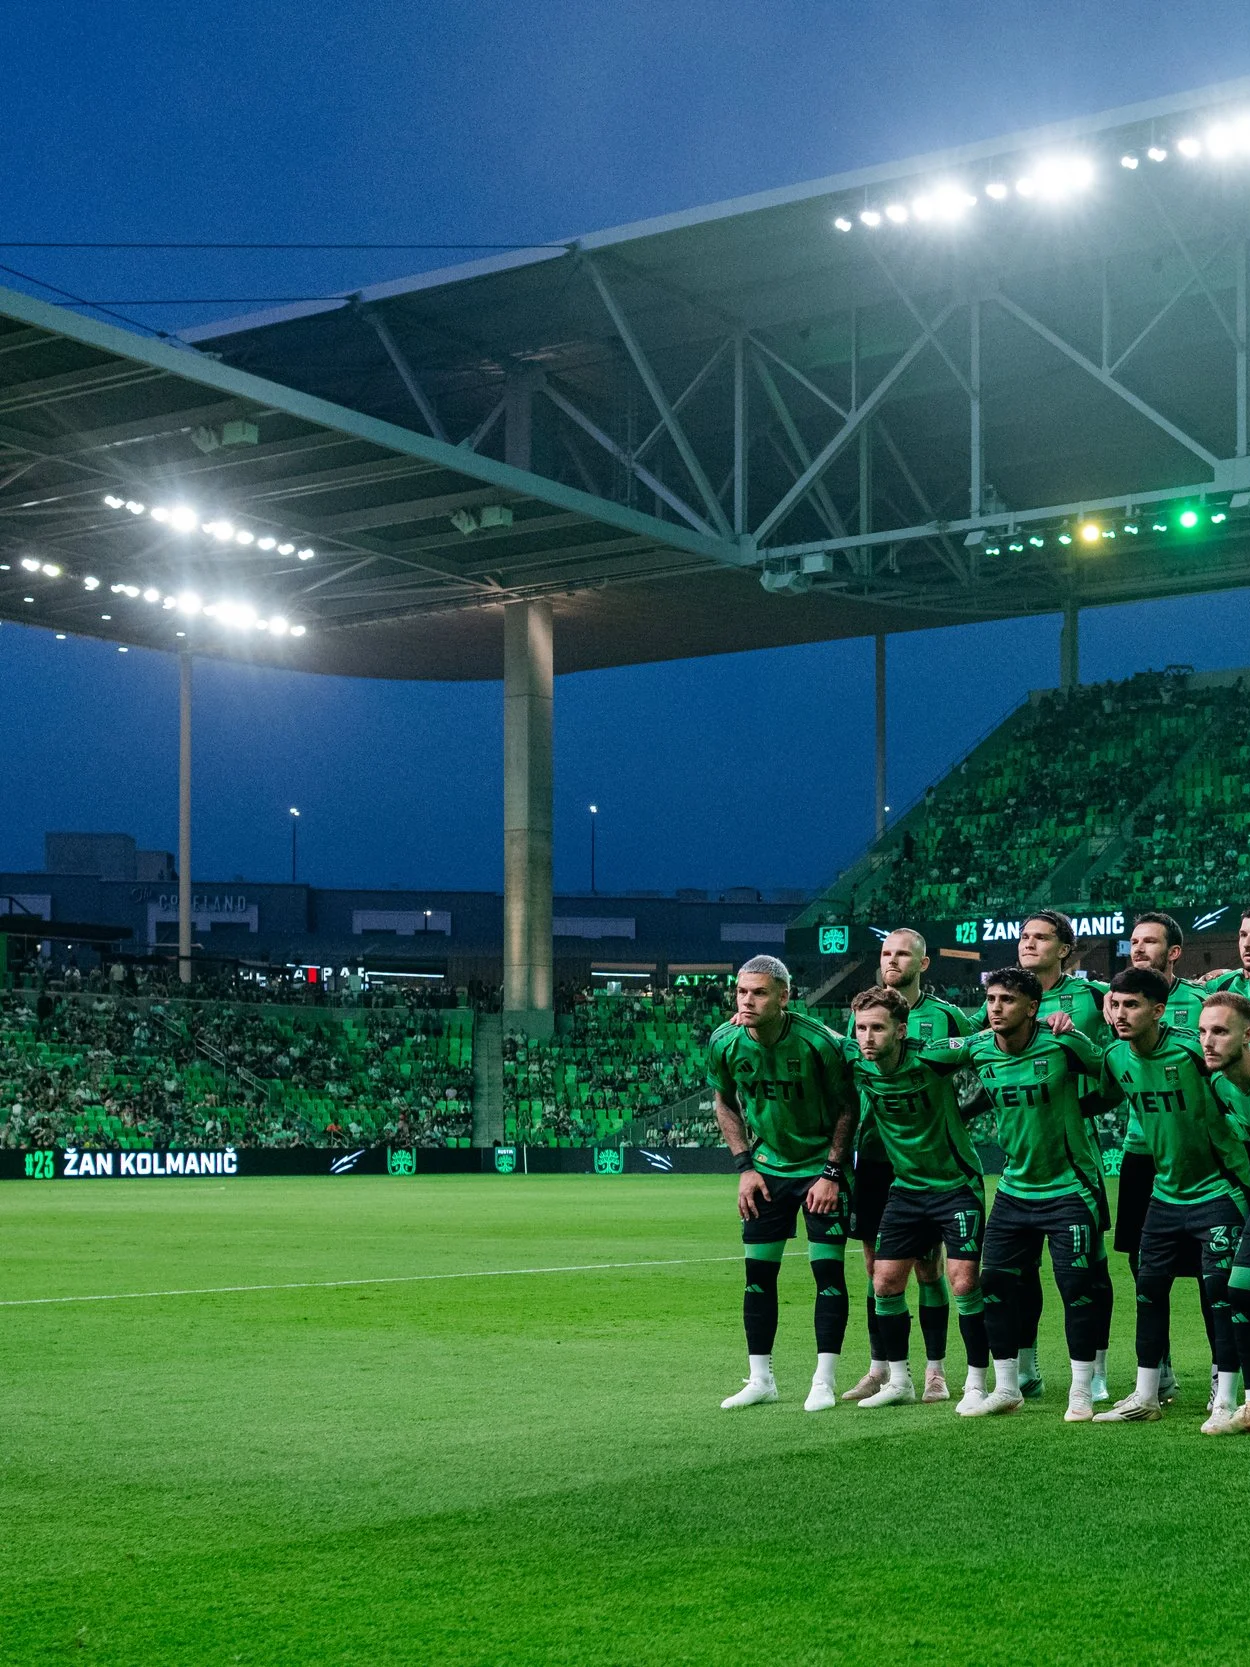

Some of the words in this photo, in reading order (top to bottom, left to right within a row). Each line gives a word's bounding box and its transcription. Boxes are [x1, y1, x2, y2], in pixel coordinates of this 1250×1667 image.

[160, 894, 246, 912] COELAND
[956, 921, 977, 944] #23
[982, 918, 1020, 941] ŽAN
[741, 1080, 804, 1101] YETI
[985, 1083, 1050, 1108] YETI
[1125, 1089, 1187, 1113] YETI
[25, 1150, 54, 1178] #23
[63, 1147, 113, 1176] ŽAN
[121, 1147, 237, 1175] KOLMANIČ
[954, 1210, 980, 1238] 17
[1069, 1224, 1090, 1253] 11
